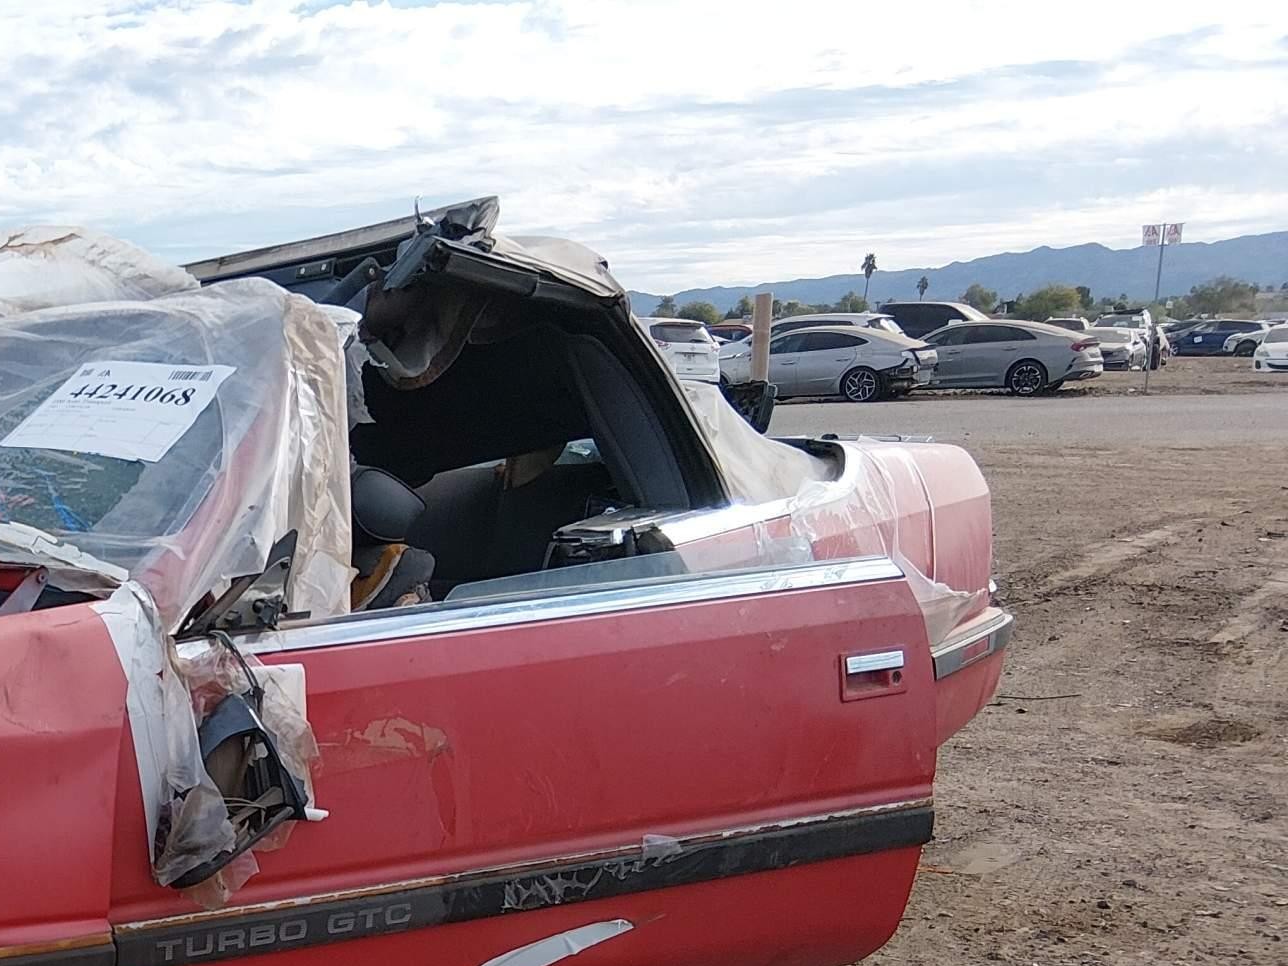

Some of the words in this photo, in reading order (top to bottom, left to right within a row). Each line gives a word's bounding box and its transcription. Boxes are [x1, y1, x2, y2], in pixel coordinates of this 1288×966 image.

[69, 383, 196, 406] 44241068
[156, 919, 307, 961] TURBO
[327, 903, 411, 934] GTC
